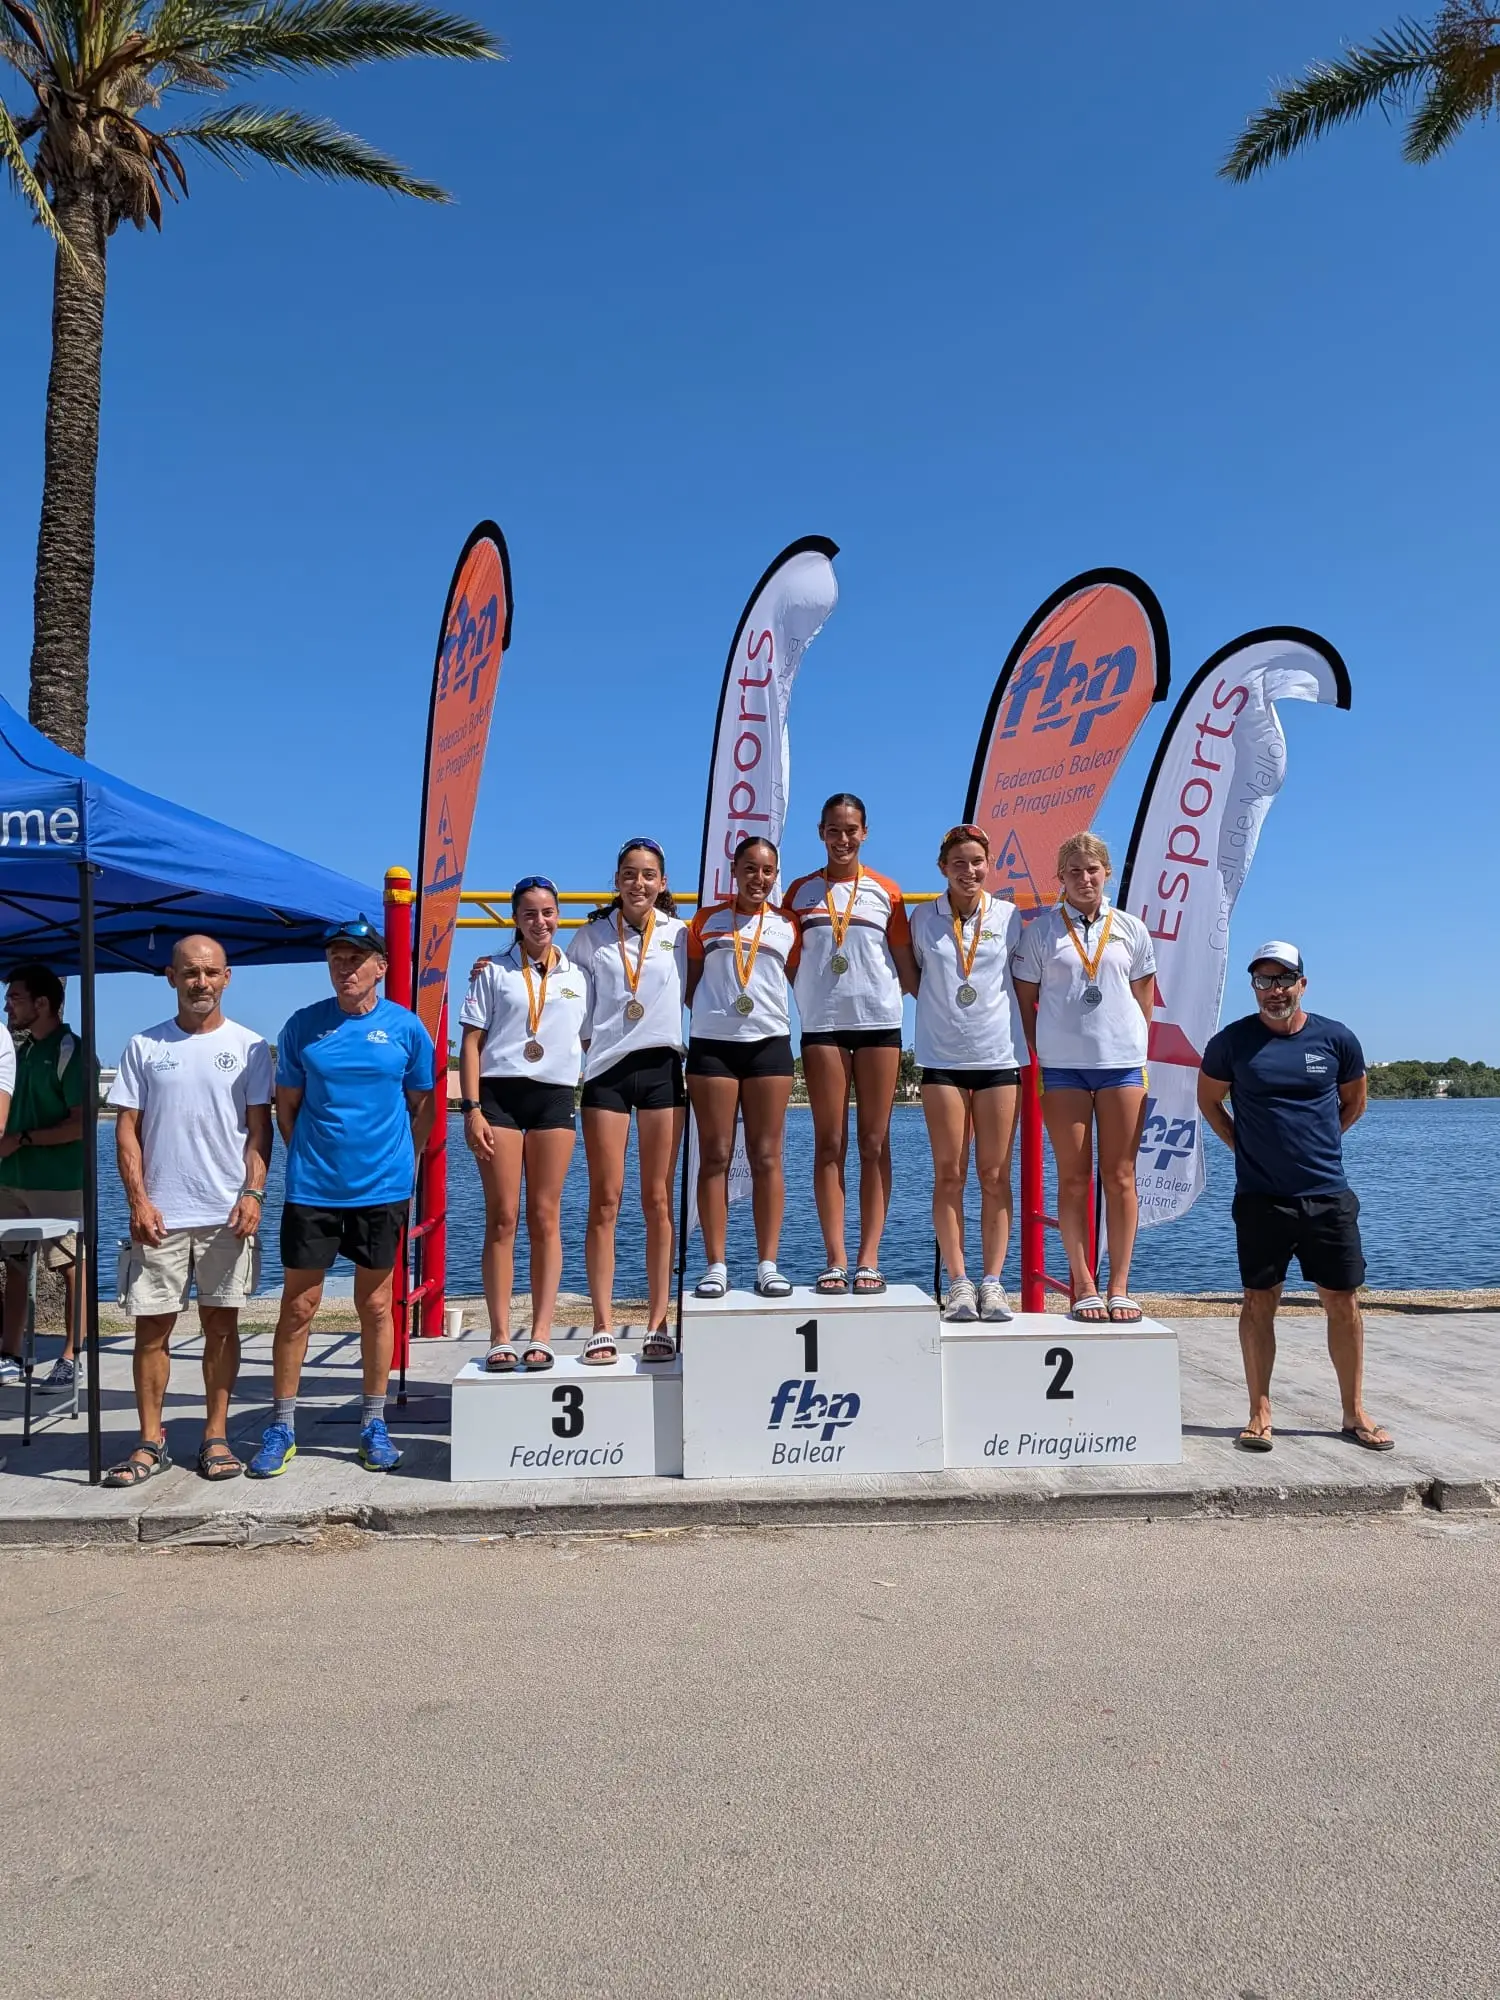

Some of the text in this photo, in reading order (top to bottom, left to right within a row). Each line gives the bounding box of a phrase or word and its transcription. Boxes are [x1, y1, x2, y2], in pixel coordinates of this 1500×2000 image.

[994, 747, 1122, 793] Federació Balear
[1239, 742, 1284, 809] Mallo
[991, 782, 1096, 819] de Piragüisme
[1141, 678, 1250, 942] Esports
[0, 807, 80, 846] me
[1226, 815, 1255, 848] de
[1155, 1176, 1193, 1193] Balear
[796, 1319, 818, 1373] 1
[1044, 1347, 1074, 1400] 2
[551, 1385, 585, 1439] 3
[509, 1442, 625, 1468] Federació
[772, 1440, 845, 1465] Balear
[984, 1433, 1137, 1460] de Piragüisme
